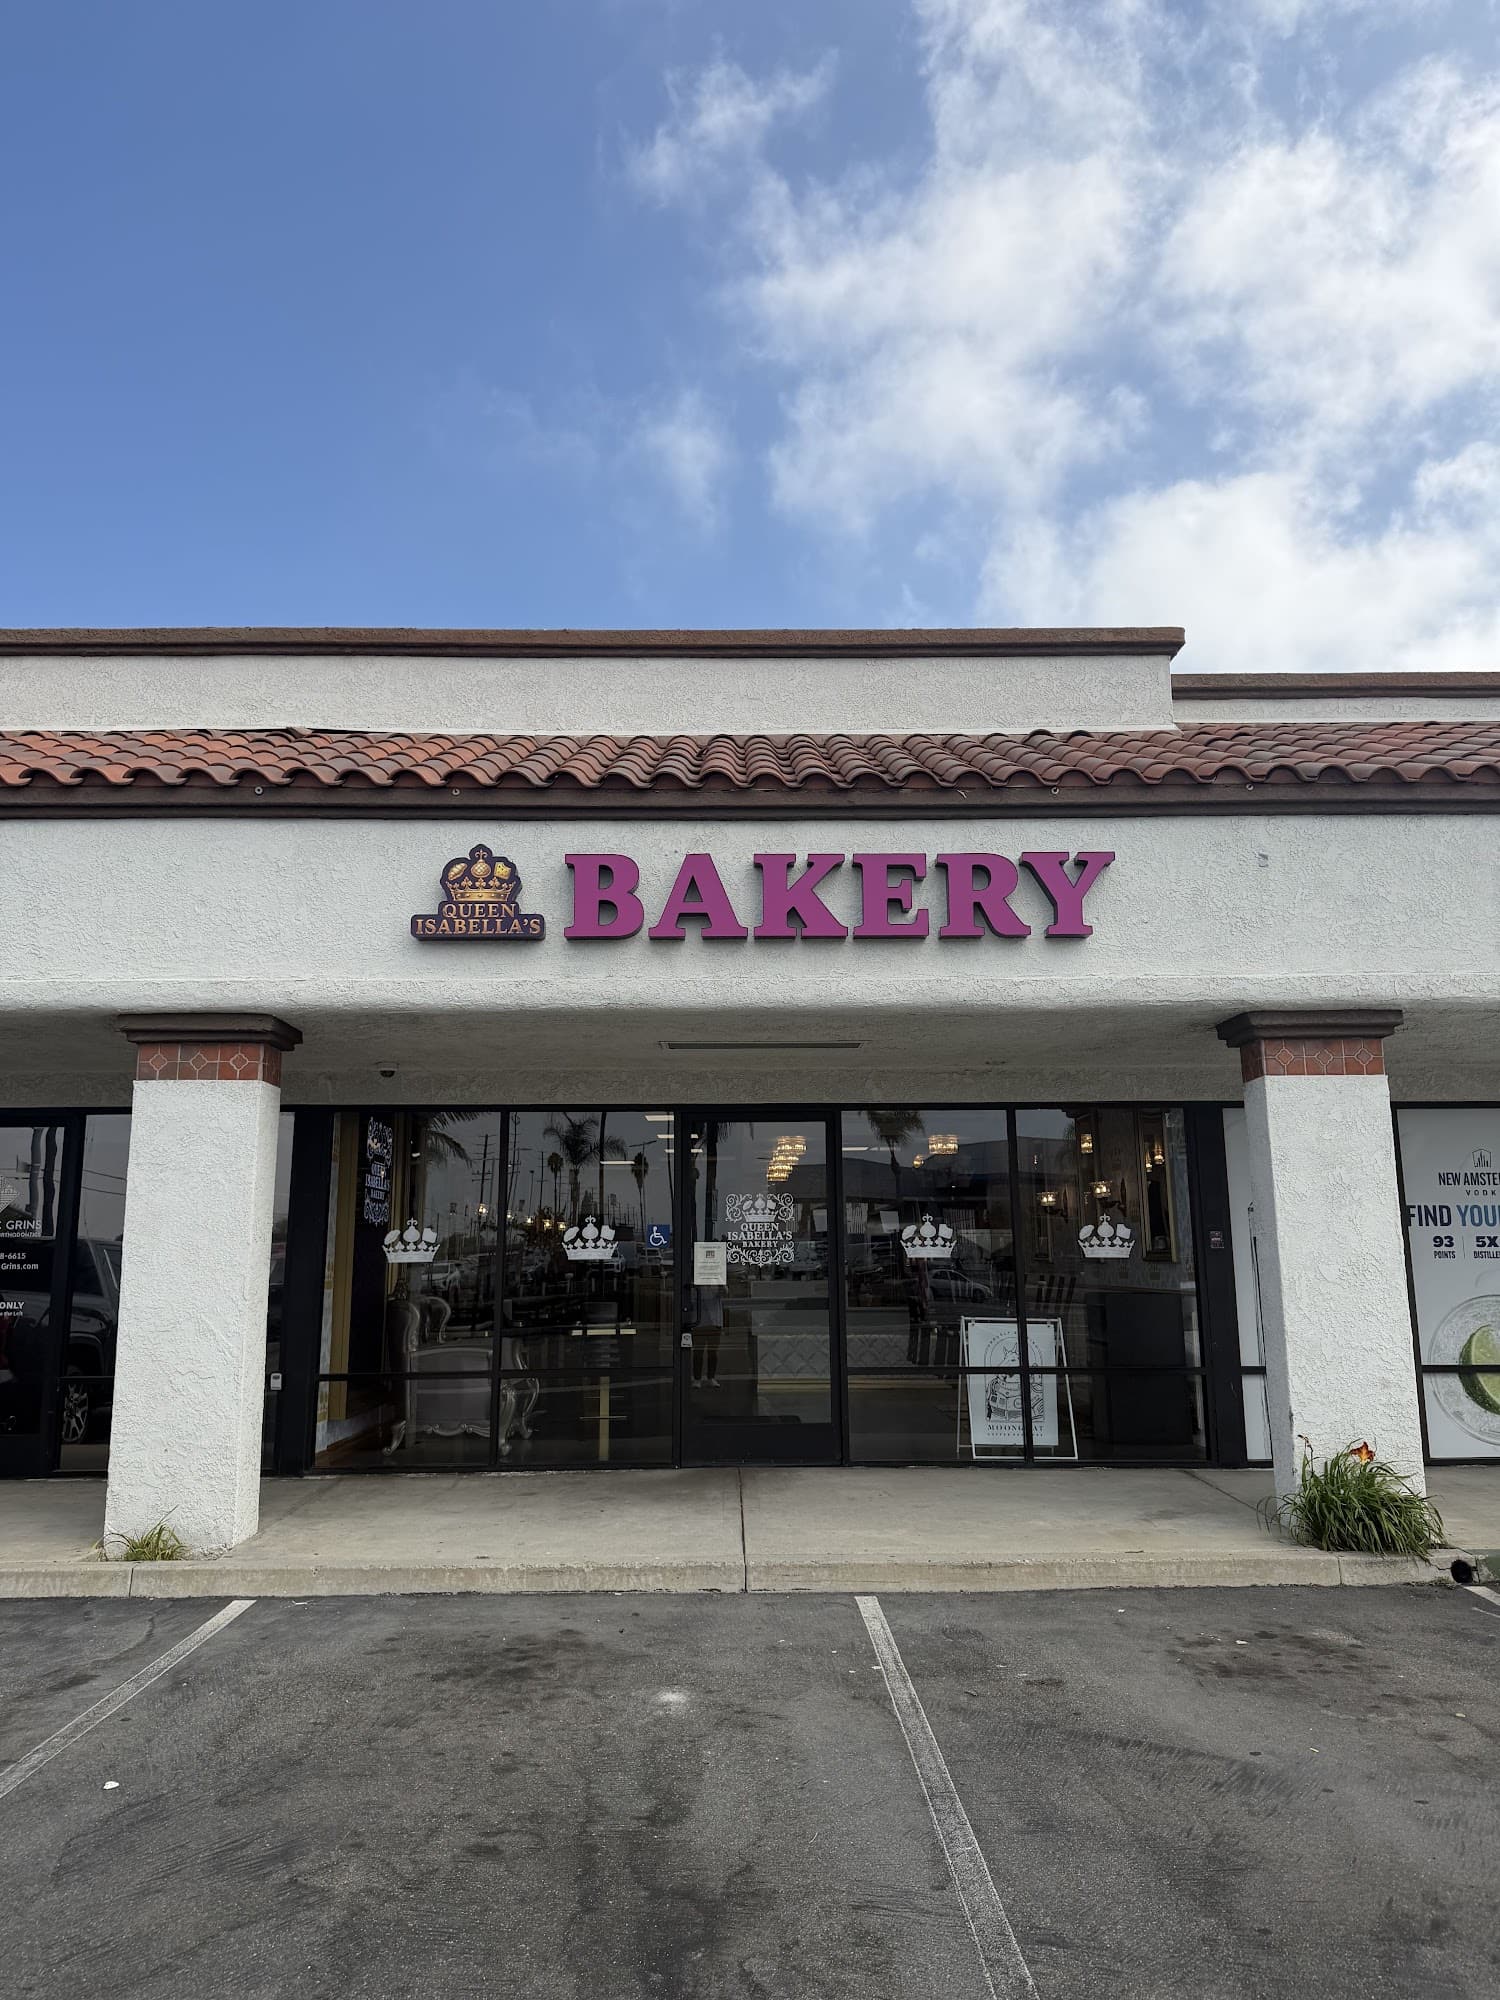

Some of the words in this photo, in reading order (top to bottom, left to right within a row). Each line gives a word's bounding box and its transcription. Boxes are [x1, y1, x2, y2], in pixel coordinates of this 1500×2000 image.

[564, 851, 1117, 939] BAKERY
[442, 903, 516, 918] QUEEN
[415, 918, 541, 935] ISABELLA'S
[1438, 1172, 1461, 1186] NEW
[1463, 1172, 1500, 1186] AMSTE
[1406, 1205, 1452, 1227] FIND
[1456, 1204, 1500, 1227] YOU
[6, 1220, 42, 1230] GRINS
[740, 1222, 780, 1232] QUEEN
[727, 1231, 793, 1241] ISABELLA'S
[1432, 1236, 1455, 1248] 93
[1475, 1236, 1500, 1248] 5X
[1433, 1250, 1456, 1259] POINTS
[0, 1301, 25, 1310] ONLY
[987, 1424, 1044, 1432] MOONGAT
